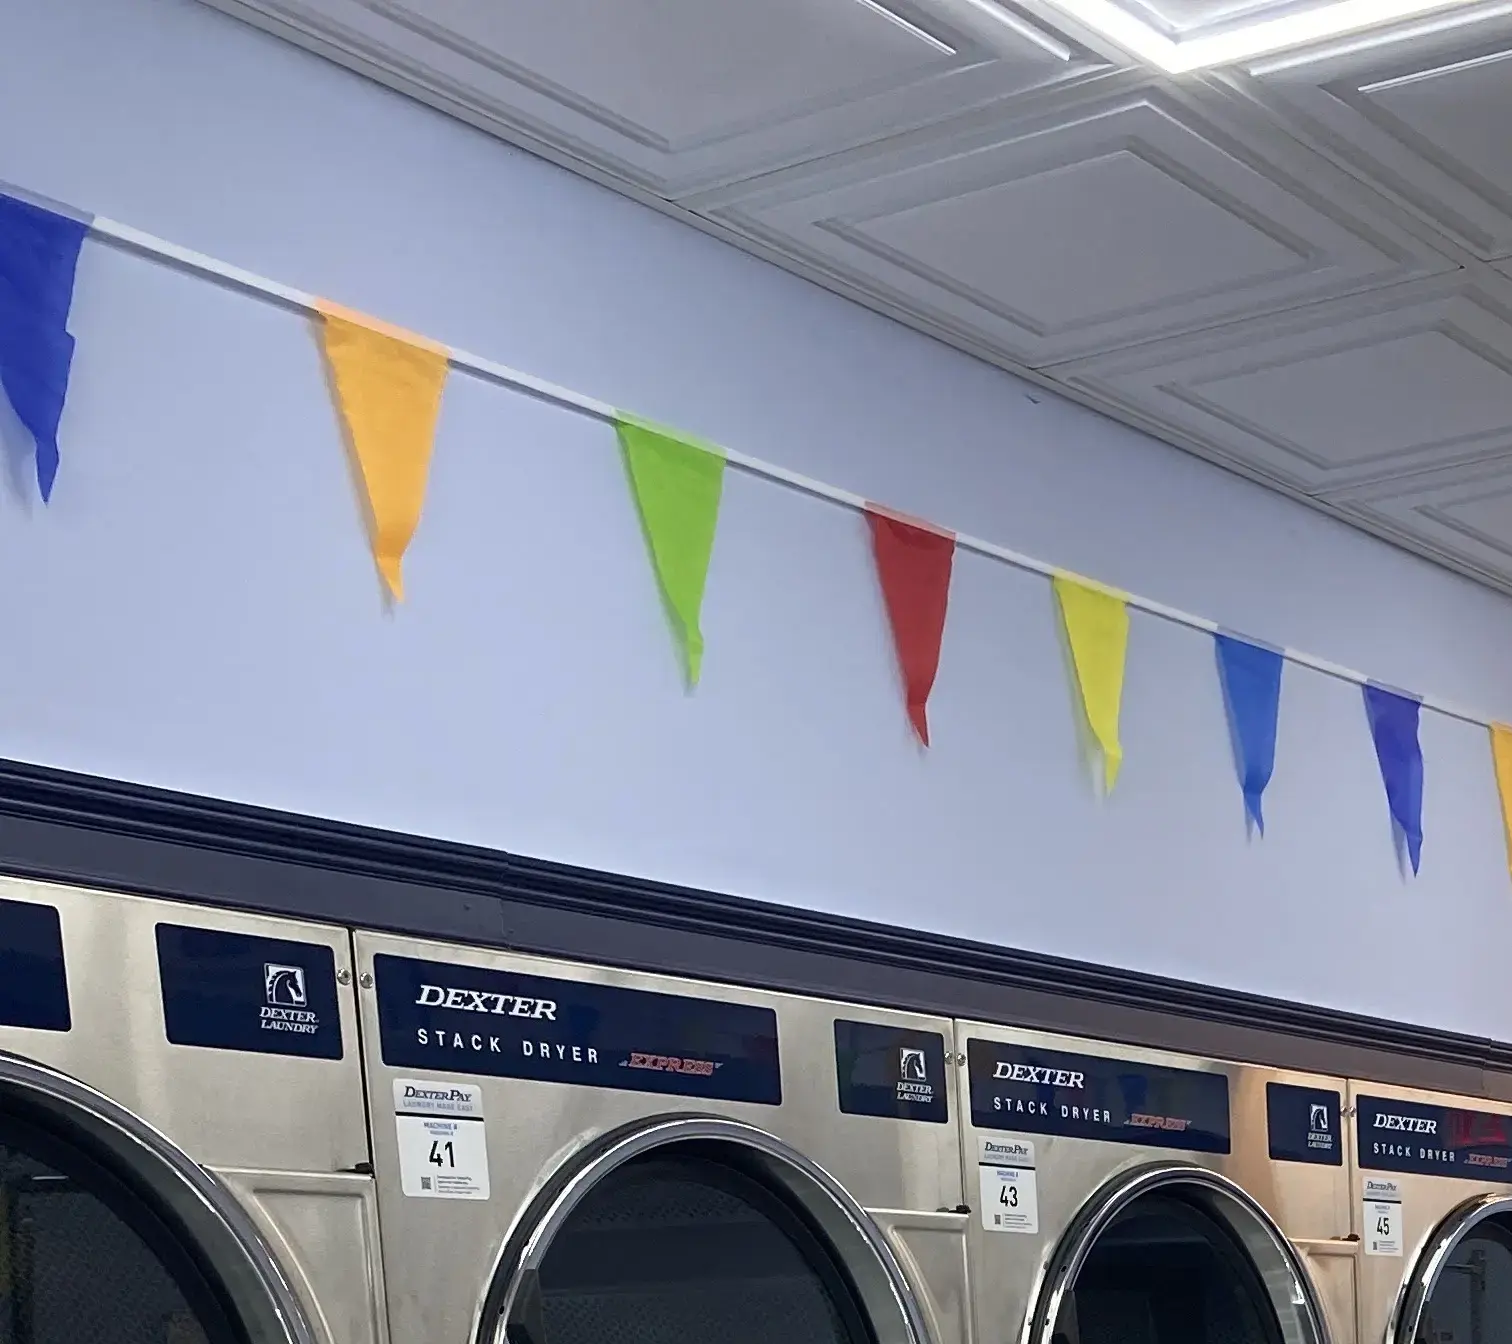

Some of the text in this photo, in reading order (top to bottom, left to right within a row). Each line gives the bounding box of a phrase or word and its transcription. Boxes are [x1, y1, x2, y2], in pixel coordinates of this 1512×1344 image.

[416, 984, 557, 1020] DEXTER
[259, 1006, 317, 1023] DEXTER
[261, 1020, 318, 1034] LAUNDRY
[417, 1028, 501, 1053] STACK
[523, 1040, 598, 1064] DRYER
[993, 1061, 1084, 1089] DEXTER
[897, 1082, 932, 1094] DEXTER
[994, 1097, 1048, 1116] STACK
[1061, 1105, 1111, 1123] DRYER
[1373, 1113, 1437, 1134] DEXTER
[429, 1140, 455, 1168] 41
[1373, 1142, 1411, 1157] STACK
[1420, 1148, 1455, 1162] DRYER
[1000, 1185, 1018, 1207] 43
[1377, 1217, 1389, 1235] 45
